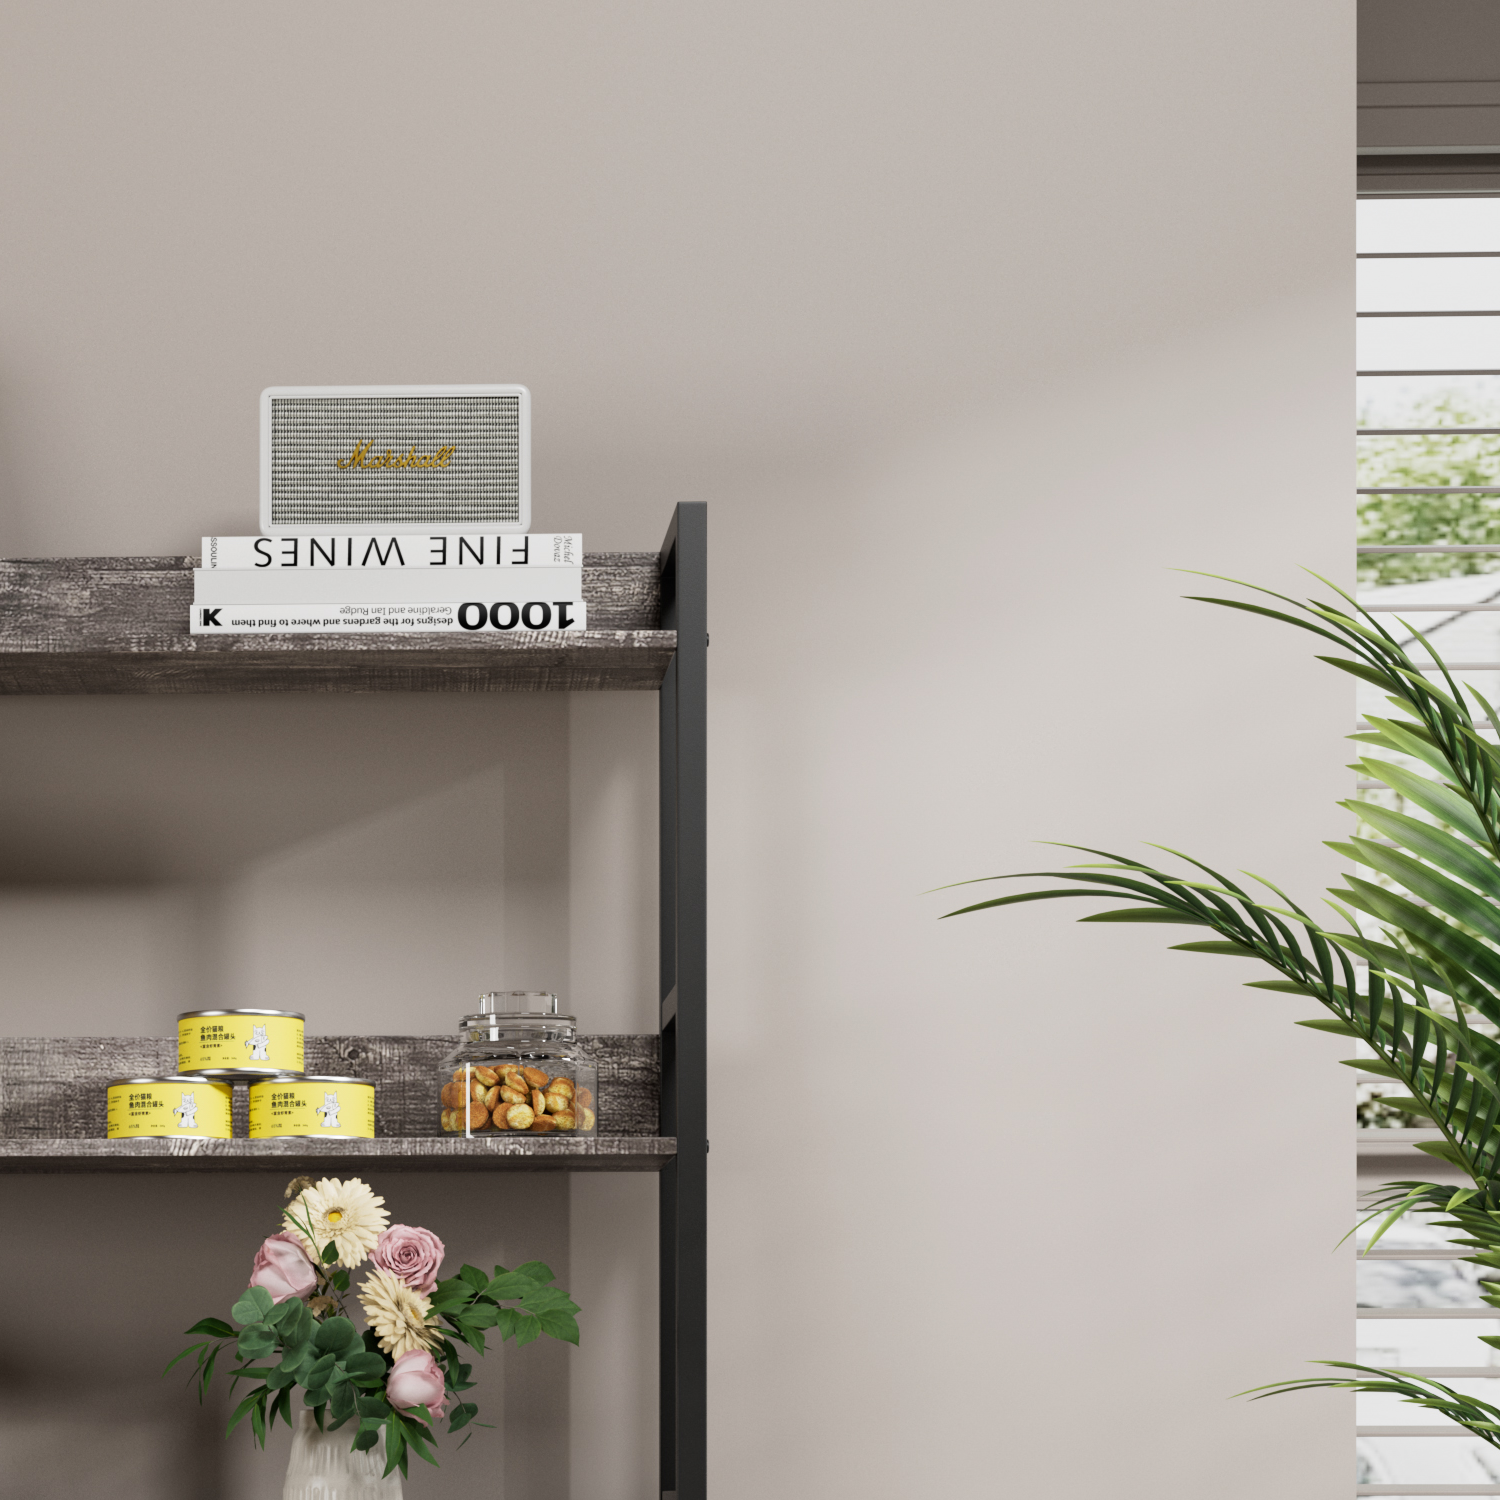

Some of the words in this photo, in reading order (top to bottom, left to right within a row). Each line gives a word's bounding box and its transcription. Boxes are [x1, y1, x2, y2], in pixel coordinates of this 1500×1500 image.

[337, 439, 456, 469] Marshall
[253, 537, 405, 568] WINES
[429, 536, 529, 566] FINE
[553, 536, 562, 562] Dovaz
[563, 536, 574, 564] Michel
[339, 605, 369, 616] Rudge
[370, 607, 386, 616] Ian
[387, 606, 406, 615] and
[407, 606, 452, 616] Geraldine
[416, 616, 453, 626] designs
[457, 601, 575, 631] 1000
[231, 618, 256, 627] them
[257, 618, 278, 628] find
[290, 619, 322, 627] where
[323, 618, 341, 627] and
[342, 617, 381, 627] gardens
[383, 618, 399, 626] the
[400, 617, 415, 627] for
